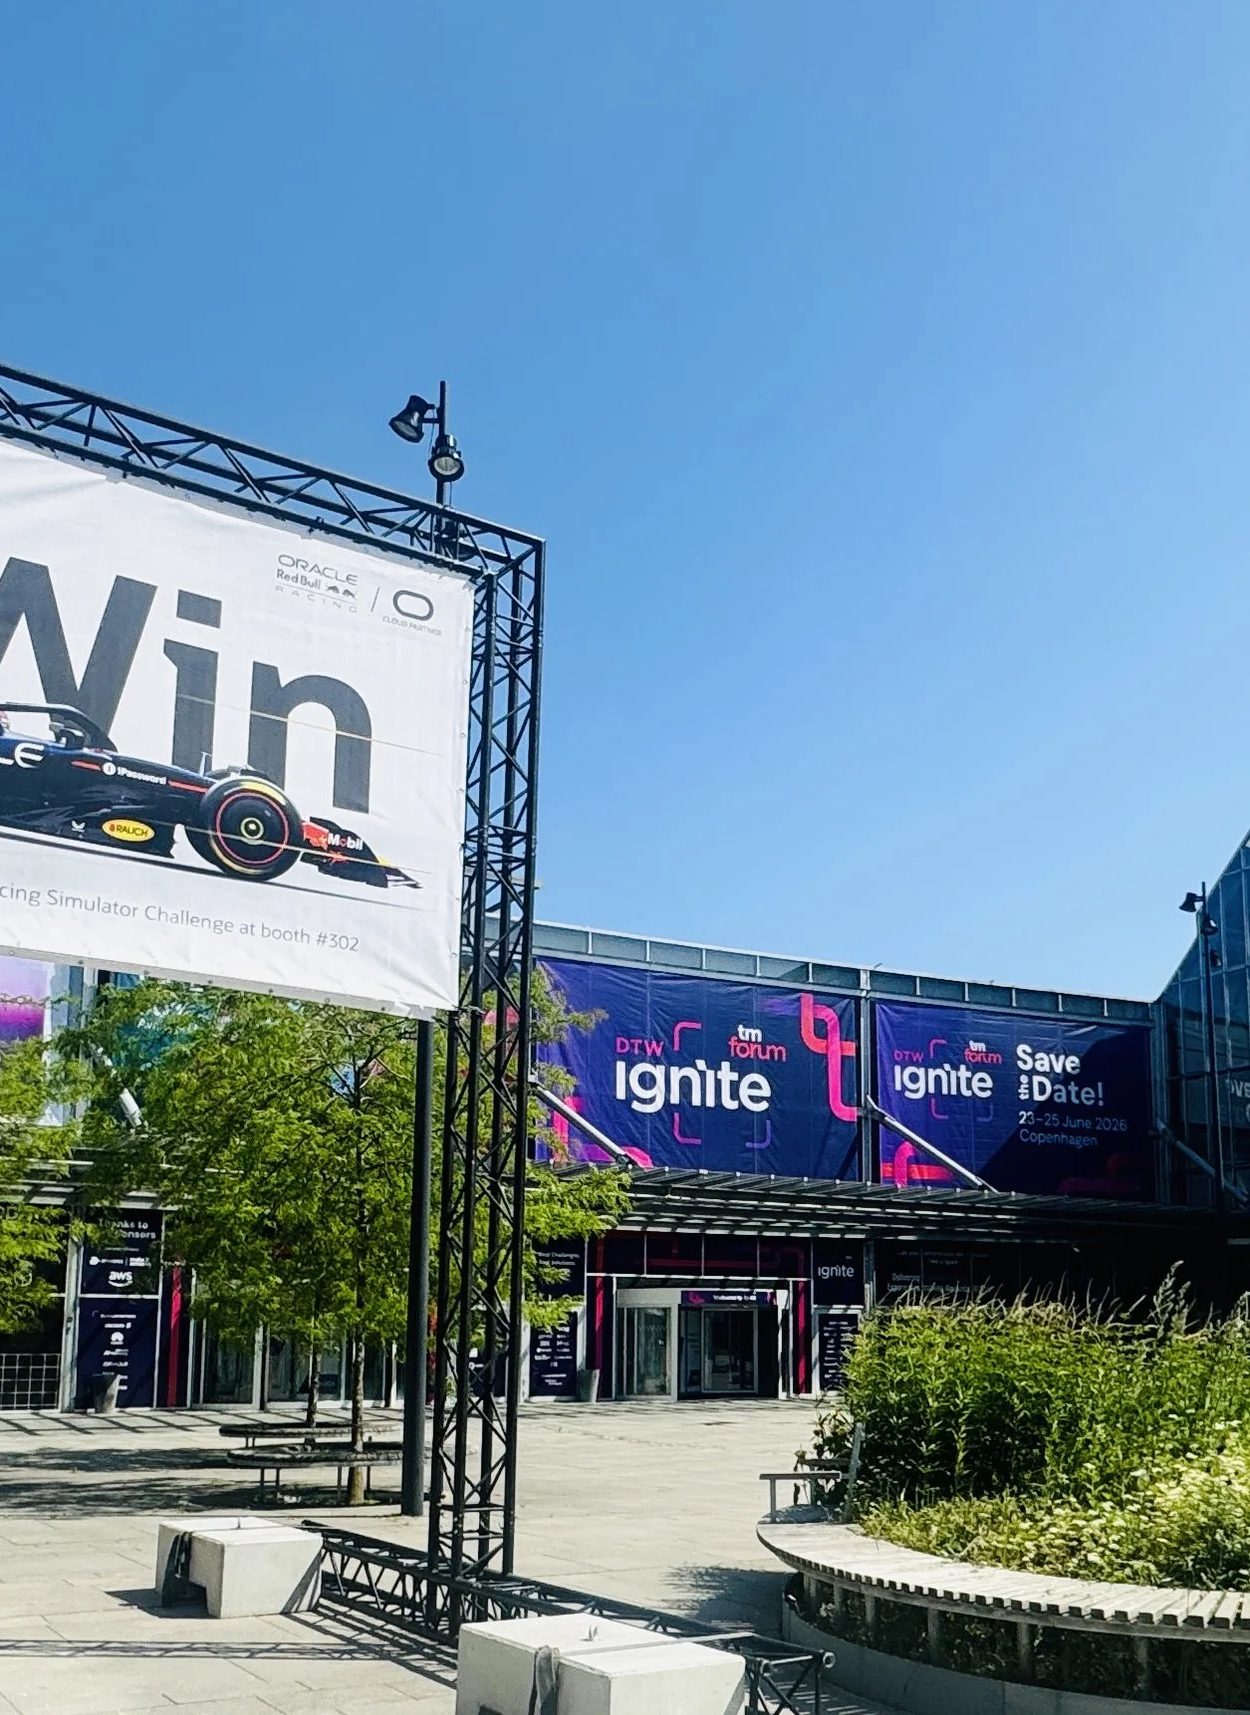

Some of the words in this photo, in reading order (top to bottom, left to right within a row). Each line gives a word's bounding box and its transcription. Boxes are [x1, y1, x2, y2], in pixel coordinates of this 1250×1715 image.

[278, 554, 358, 586] ORACLE
[275, 585, 357, 613] RACING
[114, 825, 149, 838] RAUCH
[327, 832, 363, 851] Mobil
[47, 889, 139, 918] Simulator
[144, 905, 234, 935] Challenge
[239, 921, 255, 936] at
[261, 923, 310, 945] booth
[315, 932, 359, 952] #302
[738, 1024, 762, 1042] tm
[616, 1037, 664, 1057] DTW
[728, 1036, 786, 1062] forum
[893, 1049, 924, 1063] DTW
[965, 1047, 1002, 1064] forum
[969, 1040, 986, 1052] tm
[1016, 1044, 1081, 1074] Save
[1018, 1075, 1030, 1100] the
[1032, 1075, 1104, 1106] Date!
[1062, 1112, 1092, 1129] June
[1096, 1117, 1127, 1131] 2026
[1019, 1129, 1098, 1148] Copenhagen
[108, 1271, 133, 1282] aws
